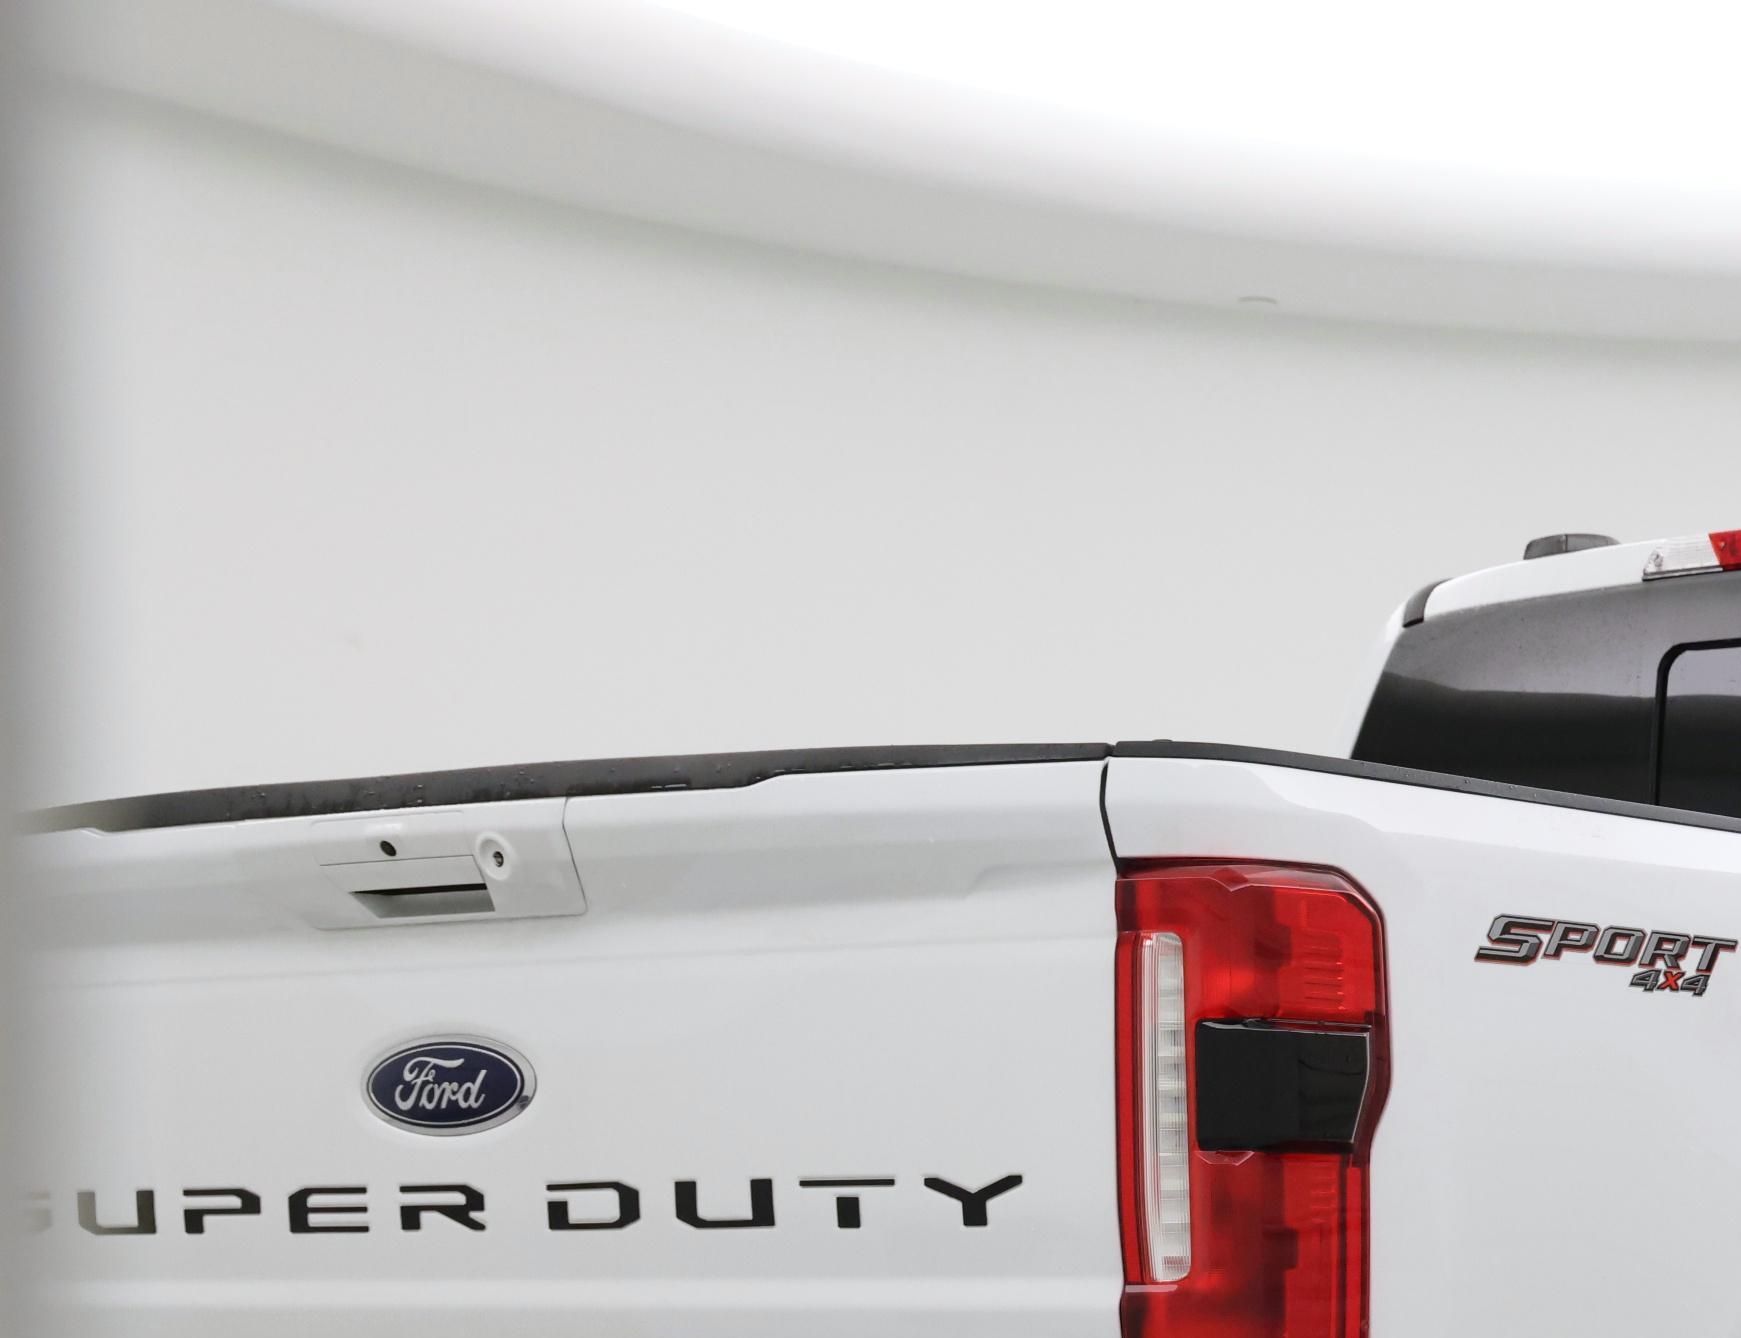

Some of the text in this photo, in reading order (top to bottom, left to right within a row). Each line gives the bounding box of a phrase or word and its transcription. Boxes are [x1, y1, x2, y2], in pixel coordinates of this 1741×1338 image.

[1474, 913, 1739, 974] SPORT
[395, 1056, 488, 1111] Ford
[546, 1174, 1023, 1231] DUTY
